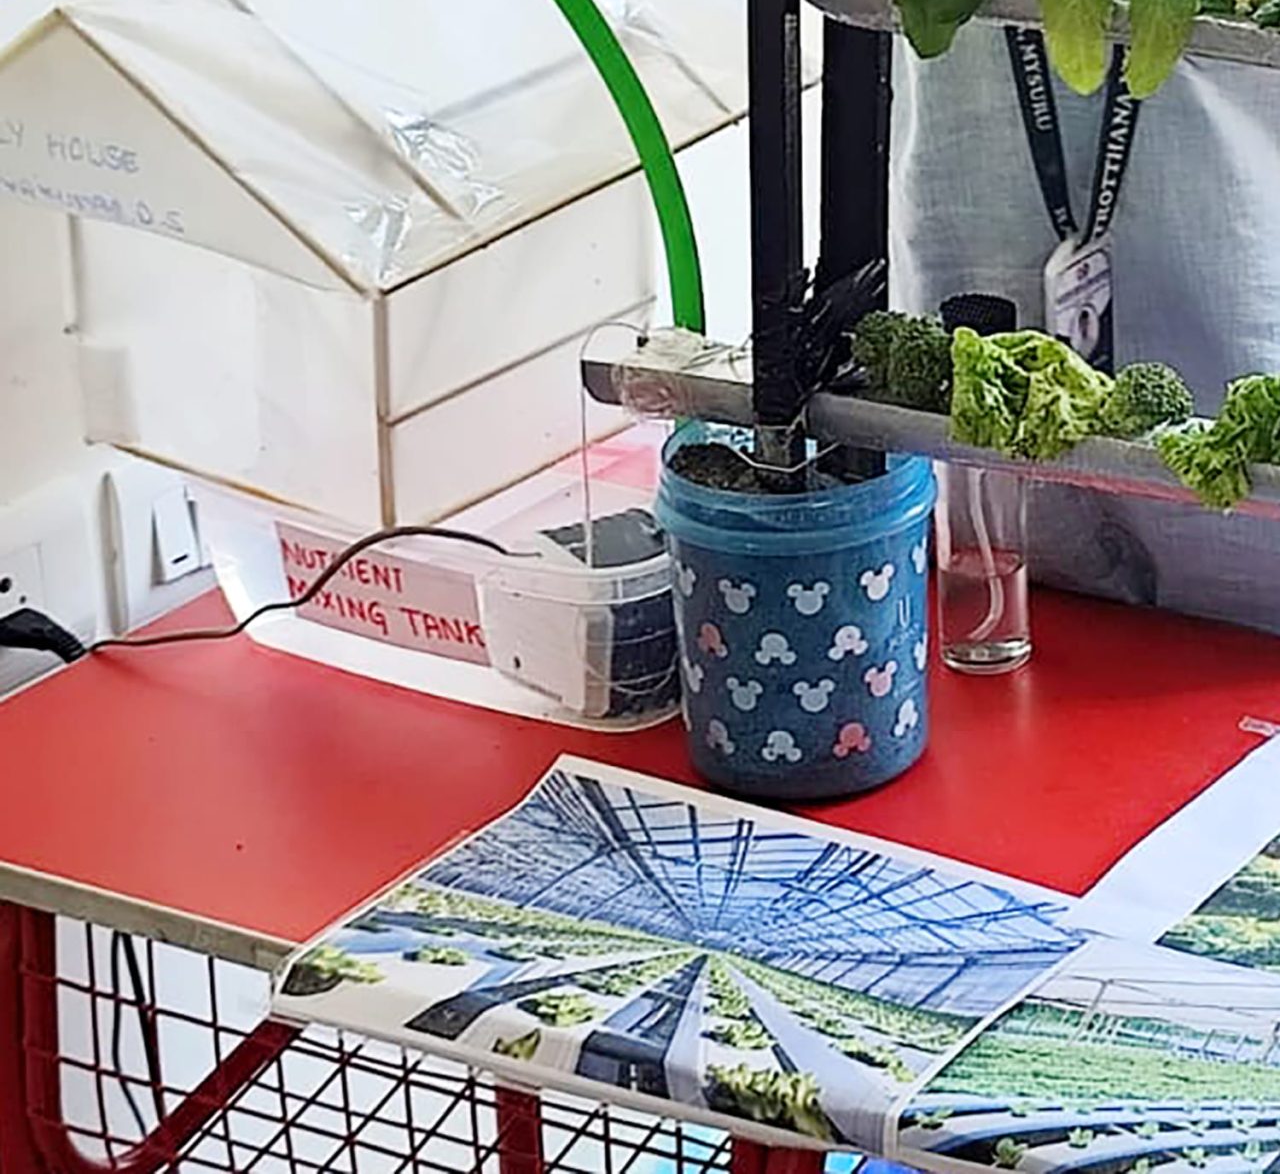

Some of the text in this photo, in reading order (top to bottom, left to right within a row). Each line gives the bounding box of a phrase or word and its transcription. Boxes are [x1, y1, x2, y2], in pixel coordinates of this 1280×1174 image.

[1018, 44, 1053, 131] MYSURU
[47, 133, 140, 173] HOUSE
[281, 538, 403, 594] NUTIENT
[401, 606, 486, 649] TANK
